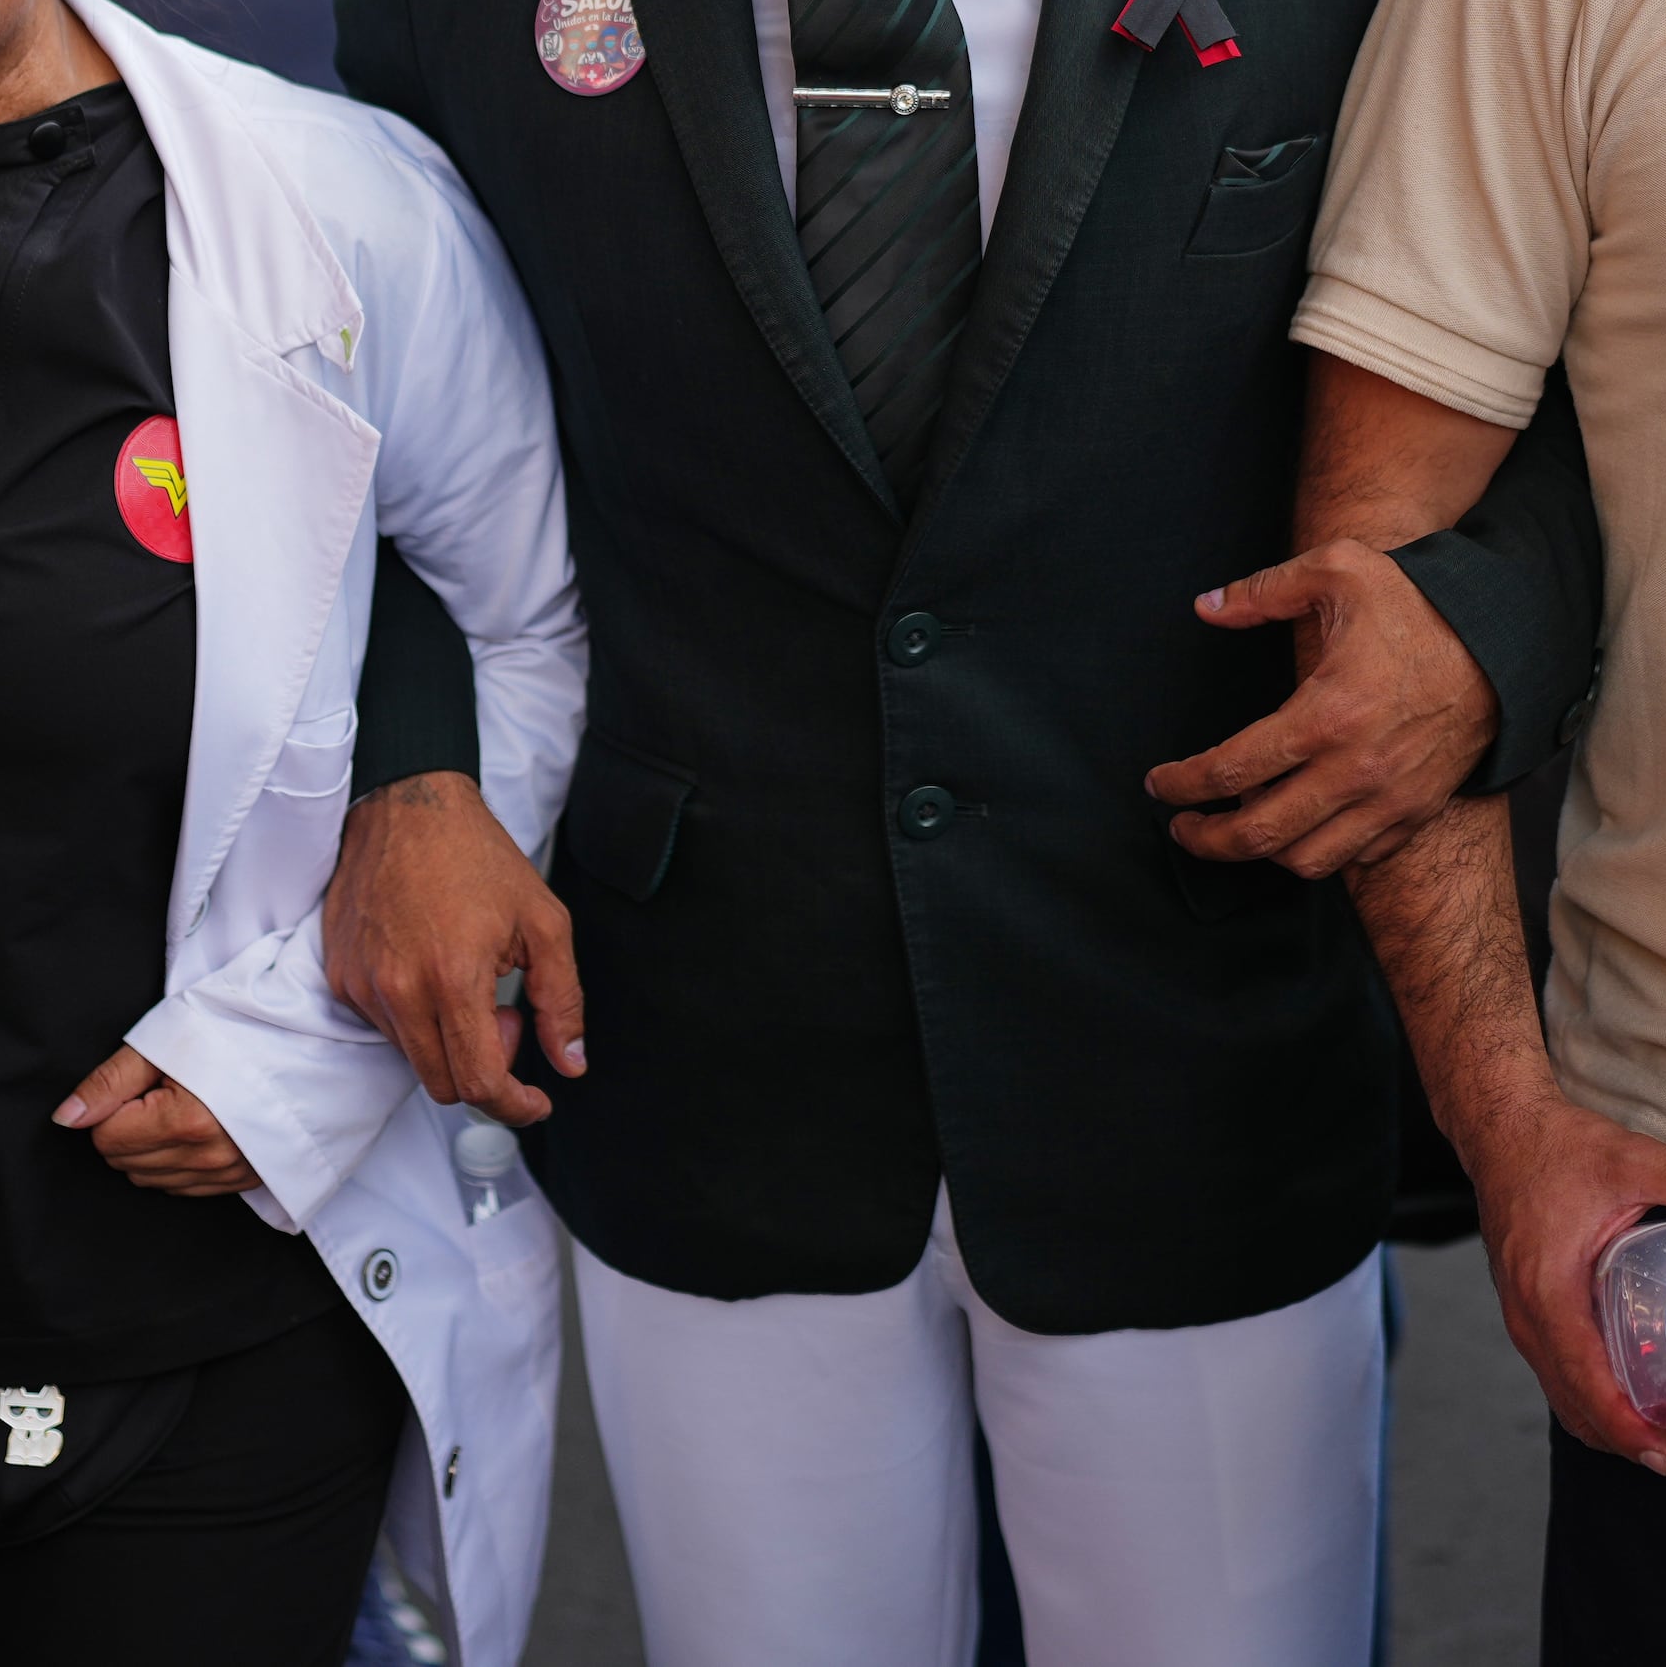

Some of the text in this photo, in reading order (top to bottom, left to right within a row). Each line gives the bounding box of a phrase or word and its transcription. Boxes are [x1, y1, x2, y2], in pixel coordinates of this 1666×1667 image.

[553, 11, 637, 31] Unidos en la Luch
